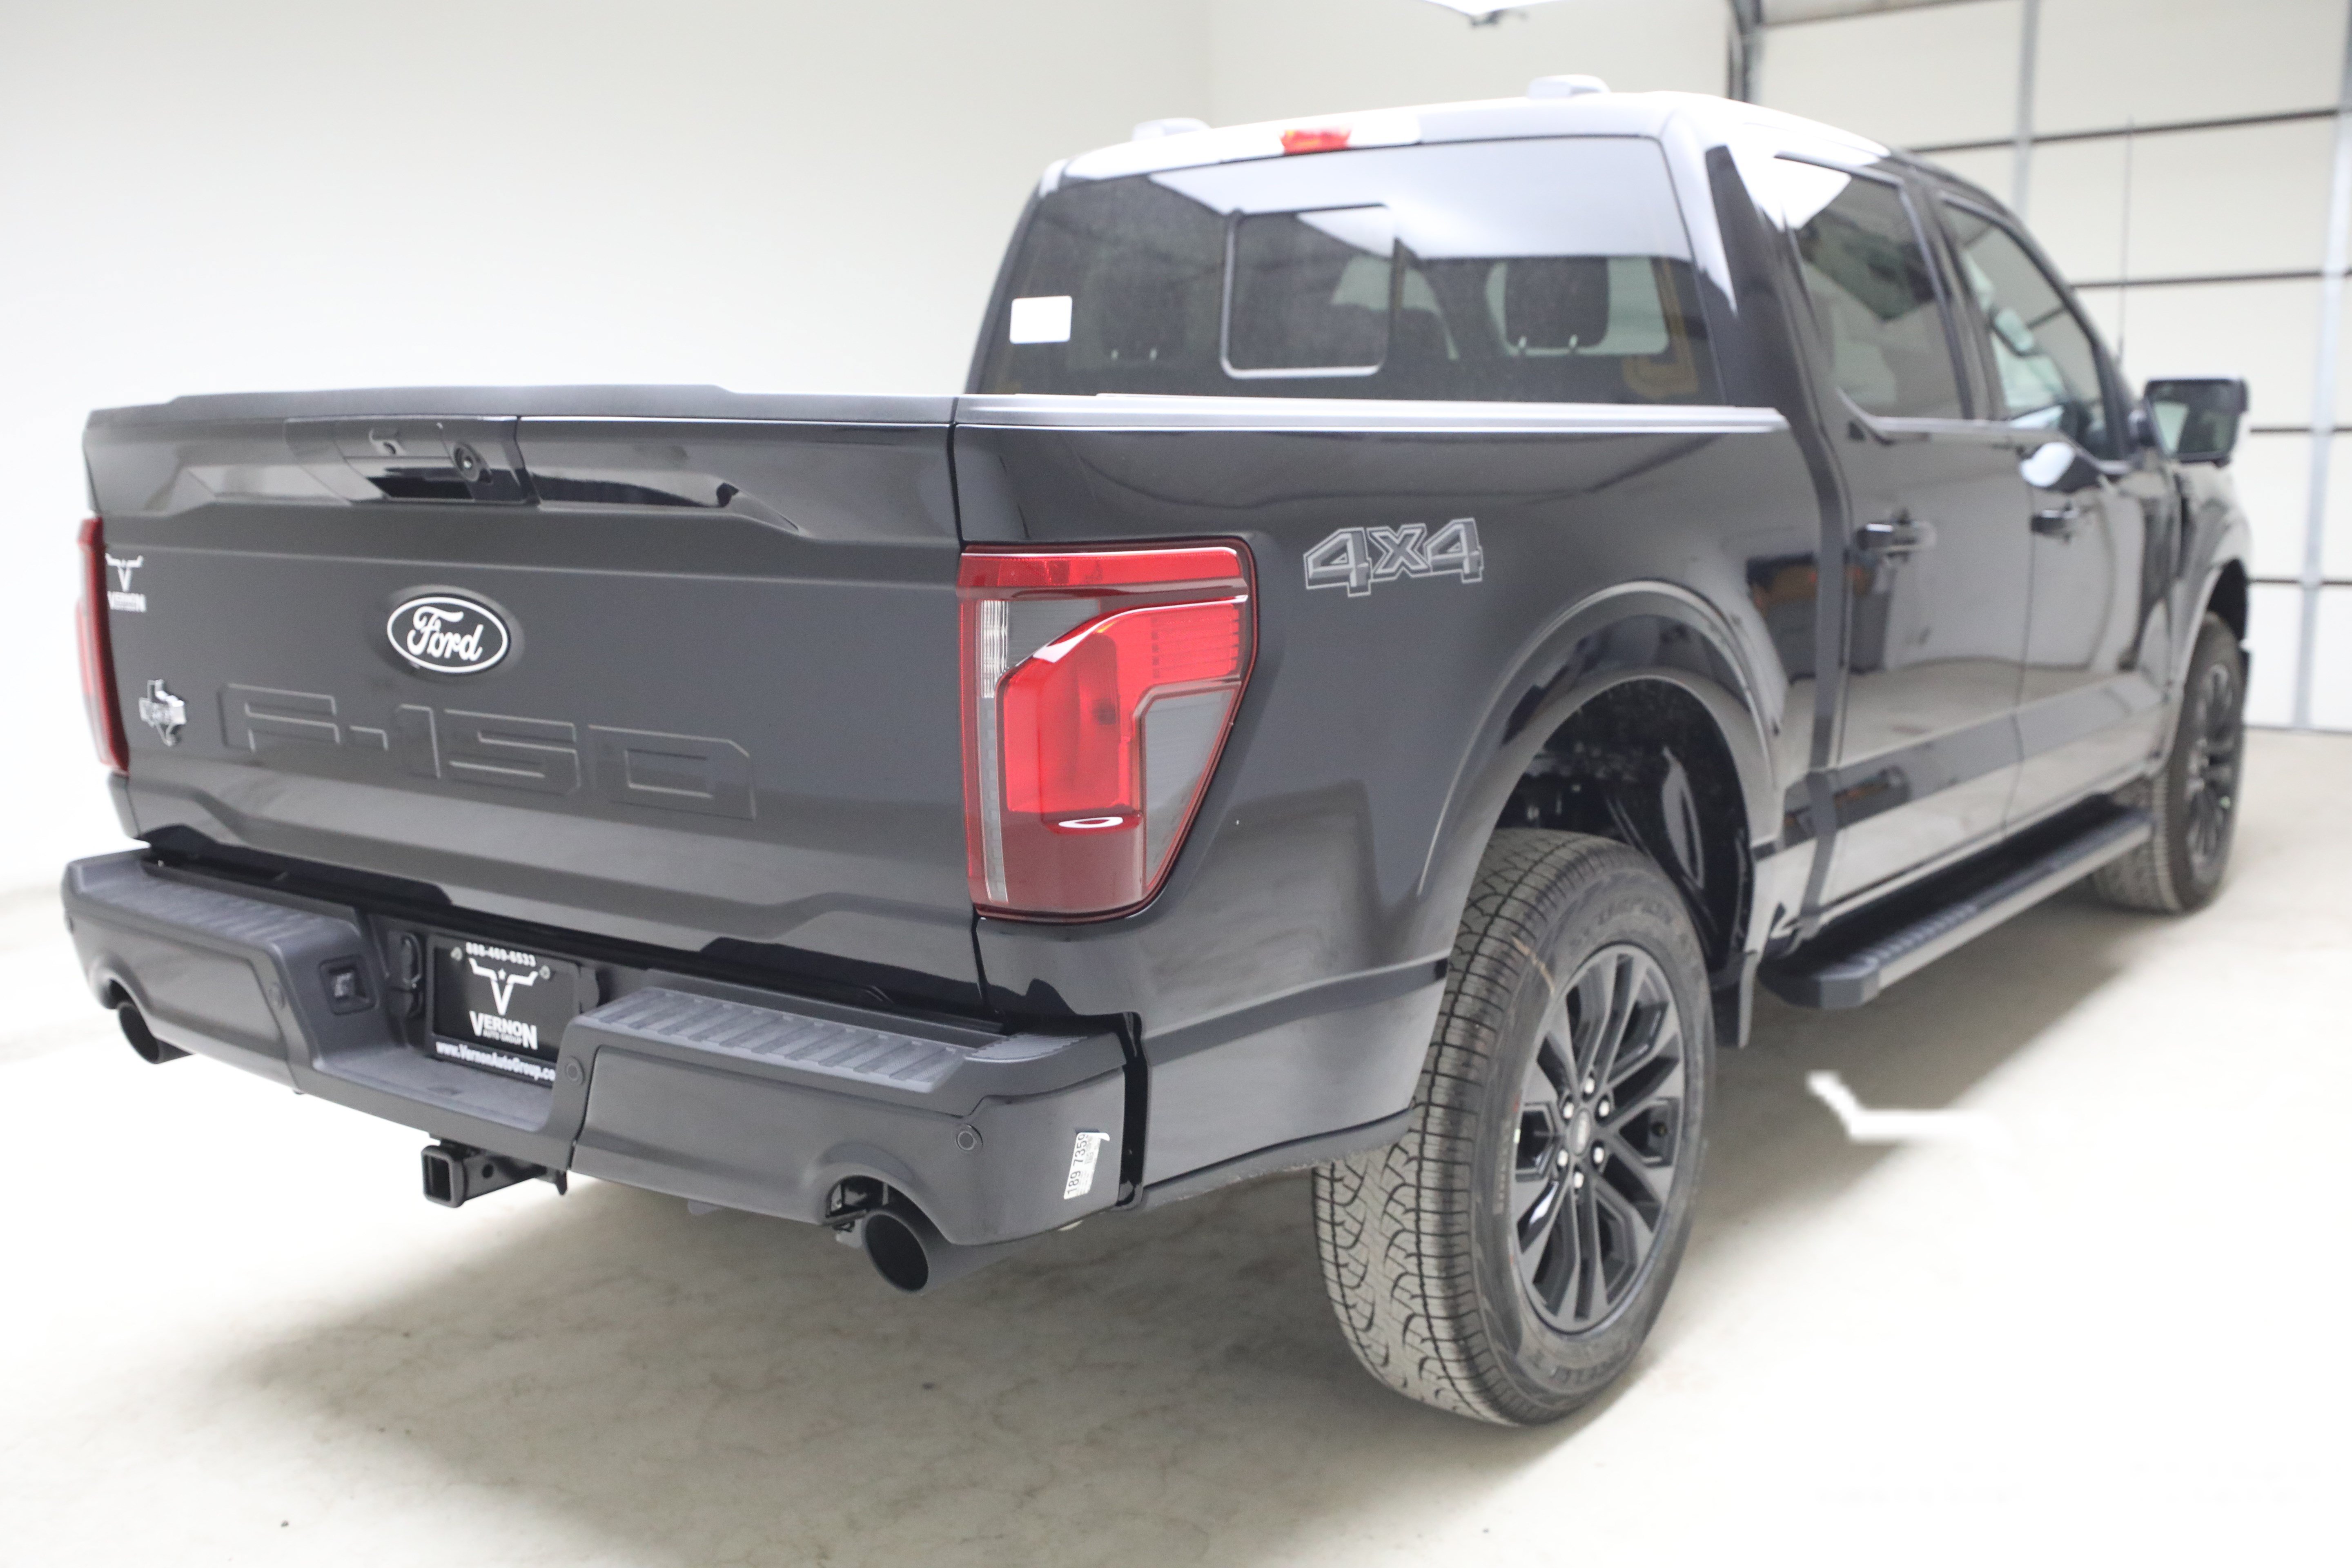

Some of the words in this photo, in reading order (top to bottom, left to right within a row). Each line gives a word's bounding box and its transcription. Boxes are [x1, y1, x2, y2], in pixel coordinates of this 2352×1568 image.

[407, 606, 483, 661] Ford
[217, 683, 757, 821] F-150
[469, 1010, 538, 1050] VERNON
[436, 1041, 556, 1081] www.VernonAutoGroup.co
[1067, 1170, 1081, 1195] 189
